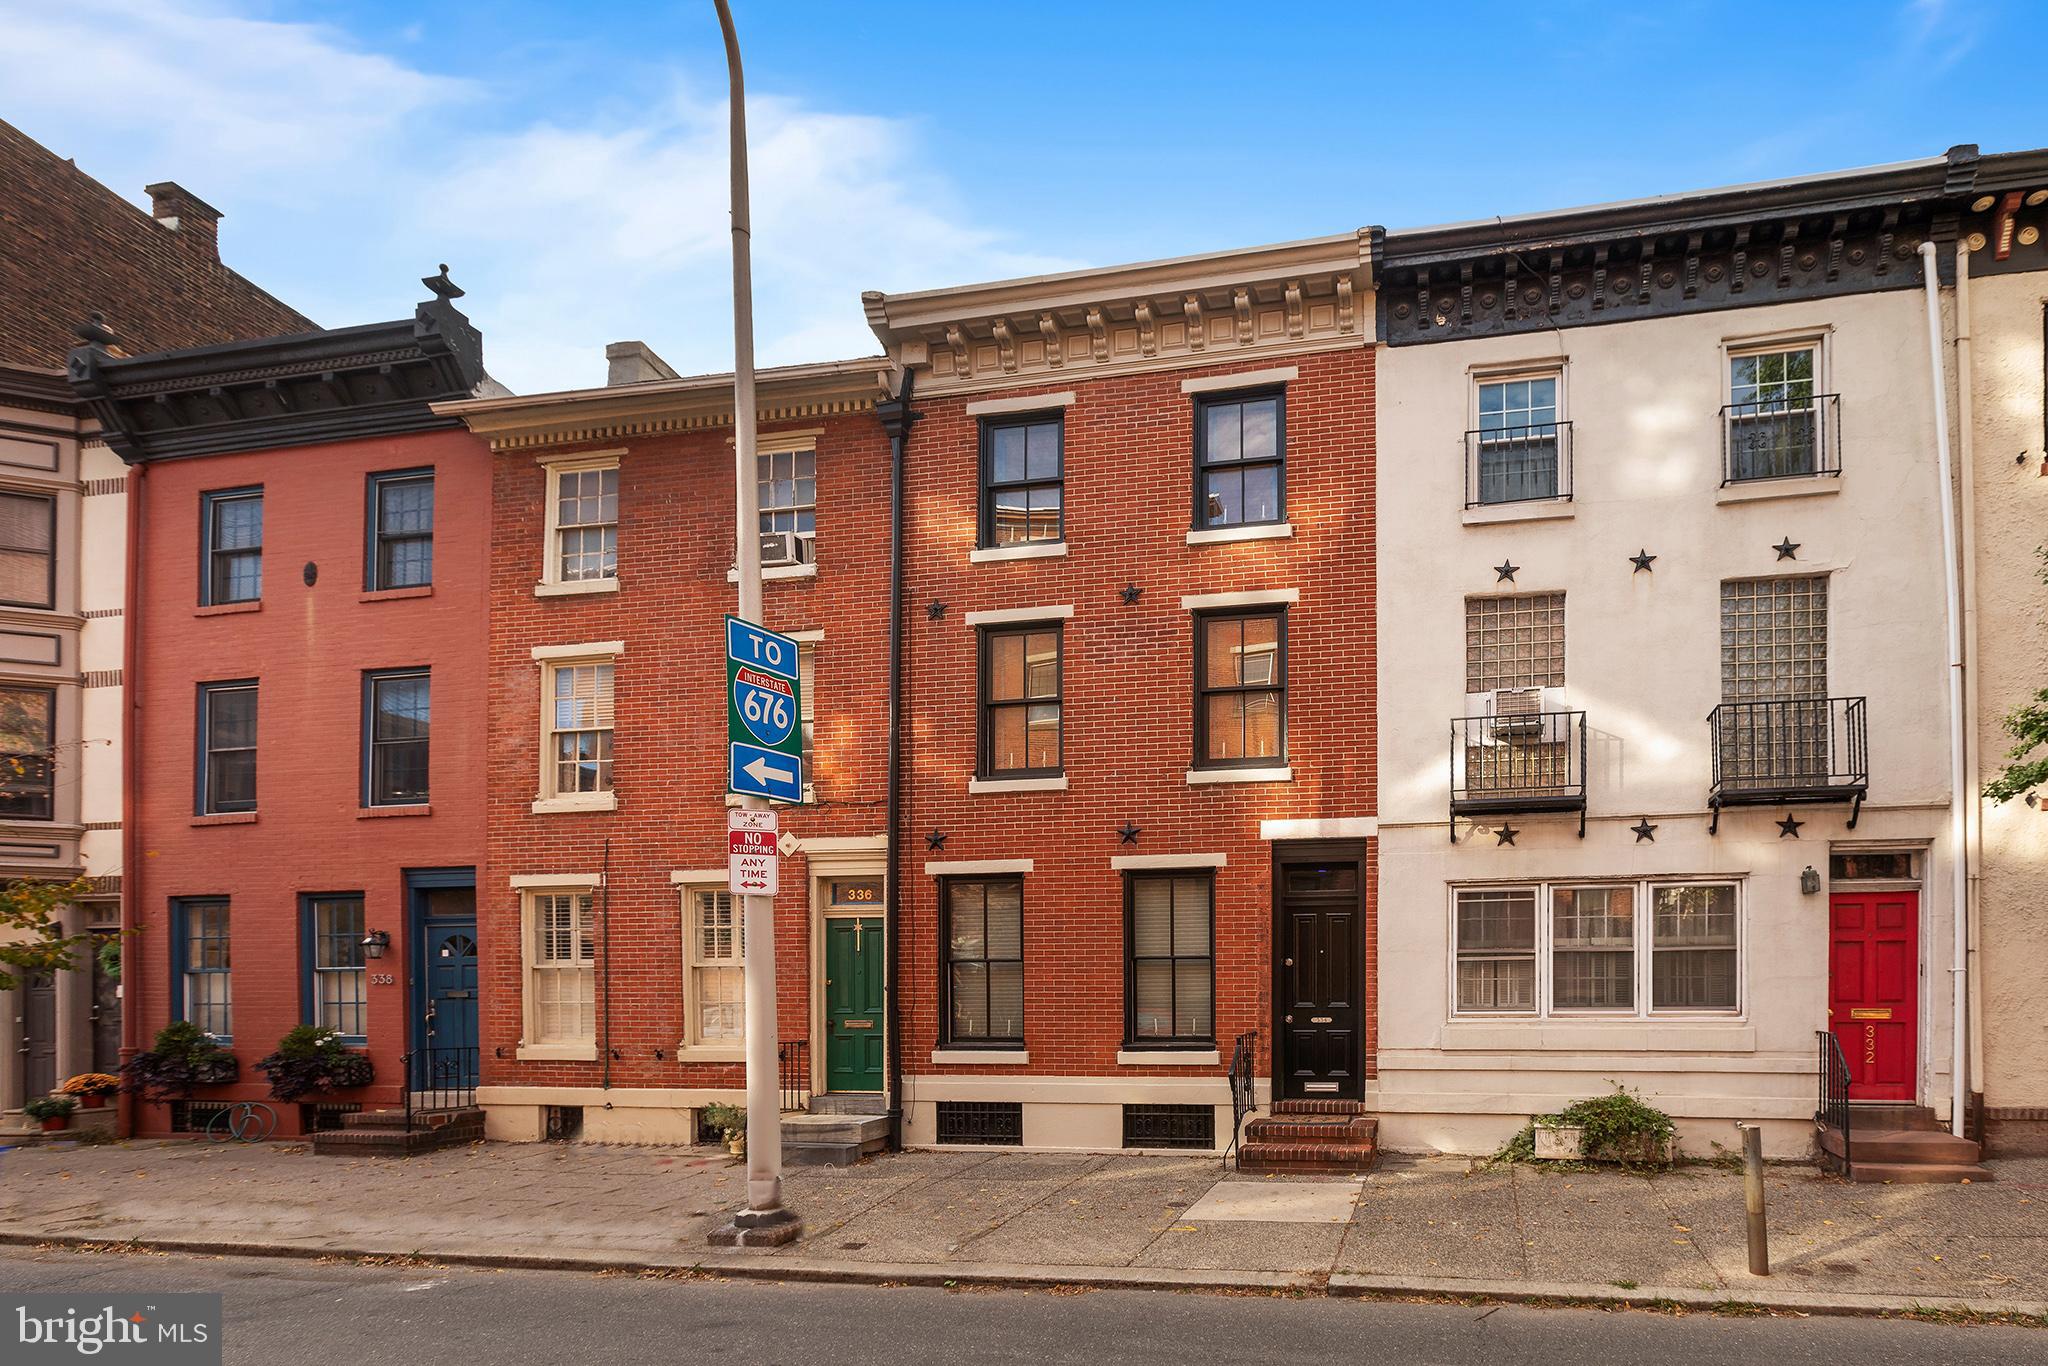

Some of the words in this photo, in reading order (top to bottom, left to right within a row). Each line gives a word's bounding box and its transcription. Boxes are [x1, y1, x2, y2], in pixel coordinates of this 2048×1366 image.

[748, 633, 782, 666] TO
[744, 672, 786, 693] INTERSTATE
[744, 688, 788, 729] 676
[744, 832, 762, 845] NO
[732, 844, 774, 855] STOPPING
[741, 858, 766, 867] ANY
[740, 869, 768, 879] TIME
[848, 889, 873, 900] 336
[370, 974, 393, 985] 338
[1865, 1025, 1875, 1064] 332
